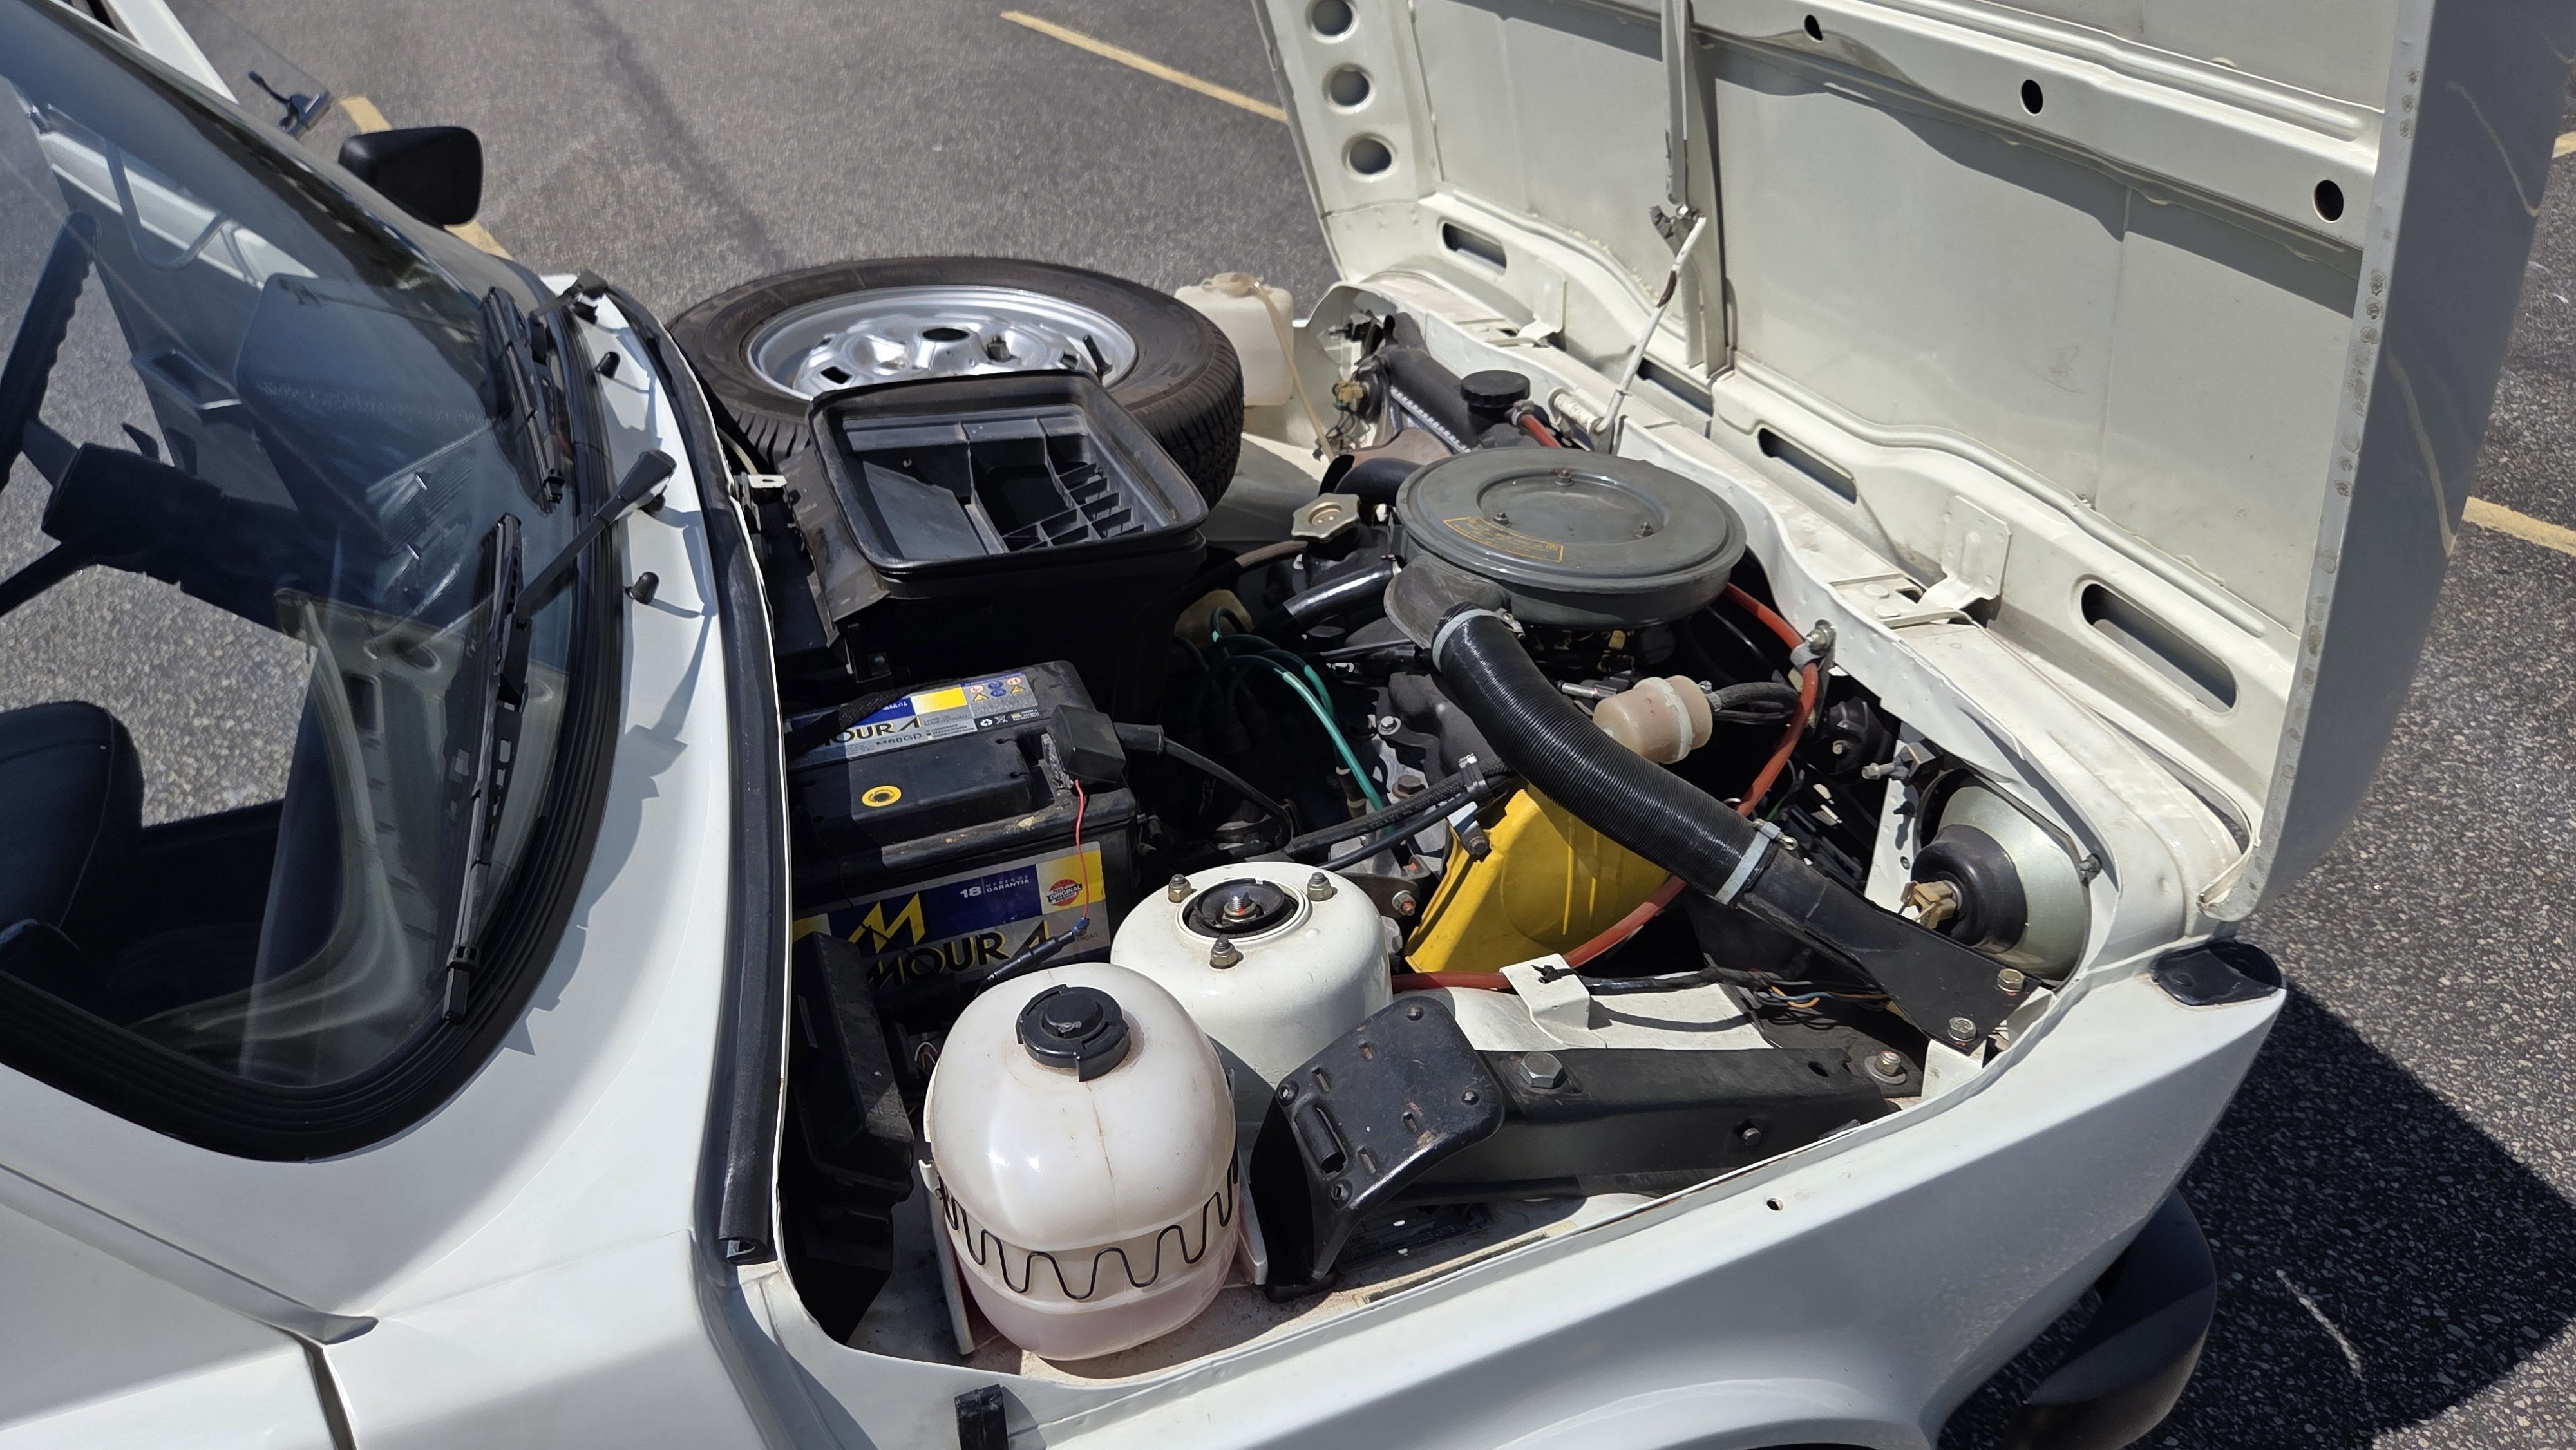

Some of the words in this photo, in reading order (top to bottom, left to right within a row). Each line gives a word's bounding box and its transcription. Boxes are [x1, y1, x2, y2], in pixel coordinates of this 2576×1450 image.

[960, 886, 983, 898] 18
[986, 878, 1030, 893] GARANTIA
[1049, 885, 1082, 899] ORIGINAL
